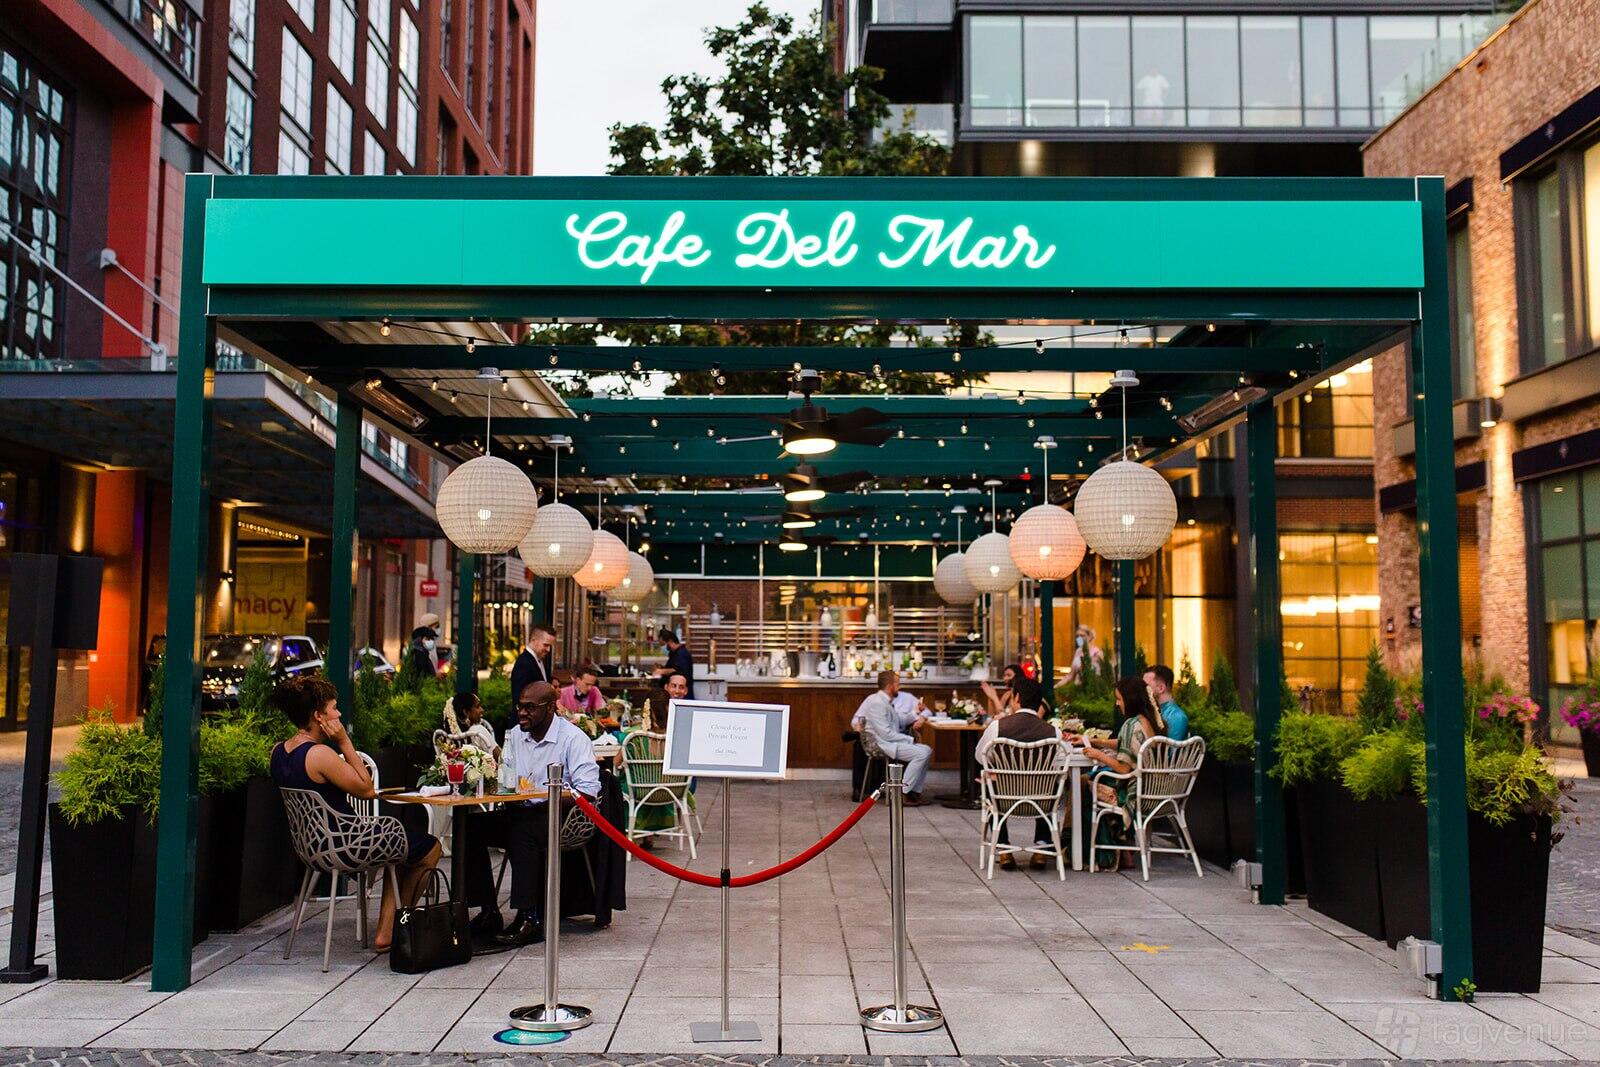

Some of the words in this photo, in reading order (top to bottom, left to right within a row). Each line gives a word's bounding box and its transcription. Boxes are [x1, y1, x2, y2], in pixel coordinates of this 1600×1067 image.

[566, 211, 711, 284] Cafe
[735, 209, 858, 269] Del
[878, 214, 1056, 269] Mar
